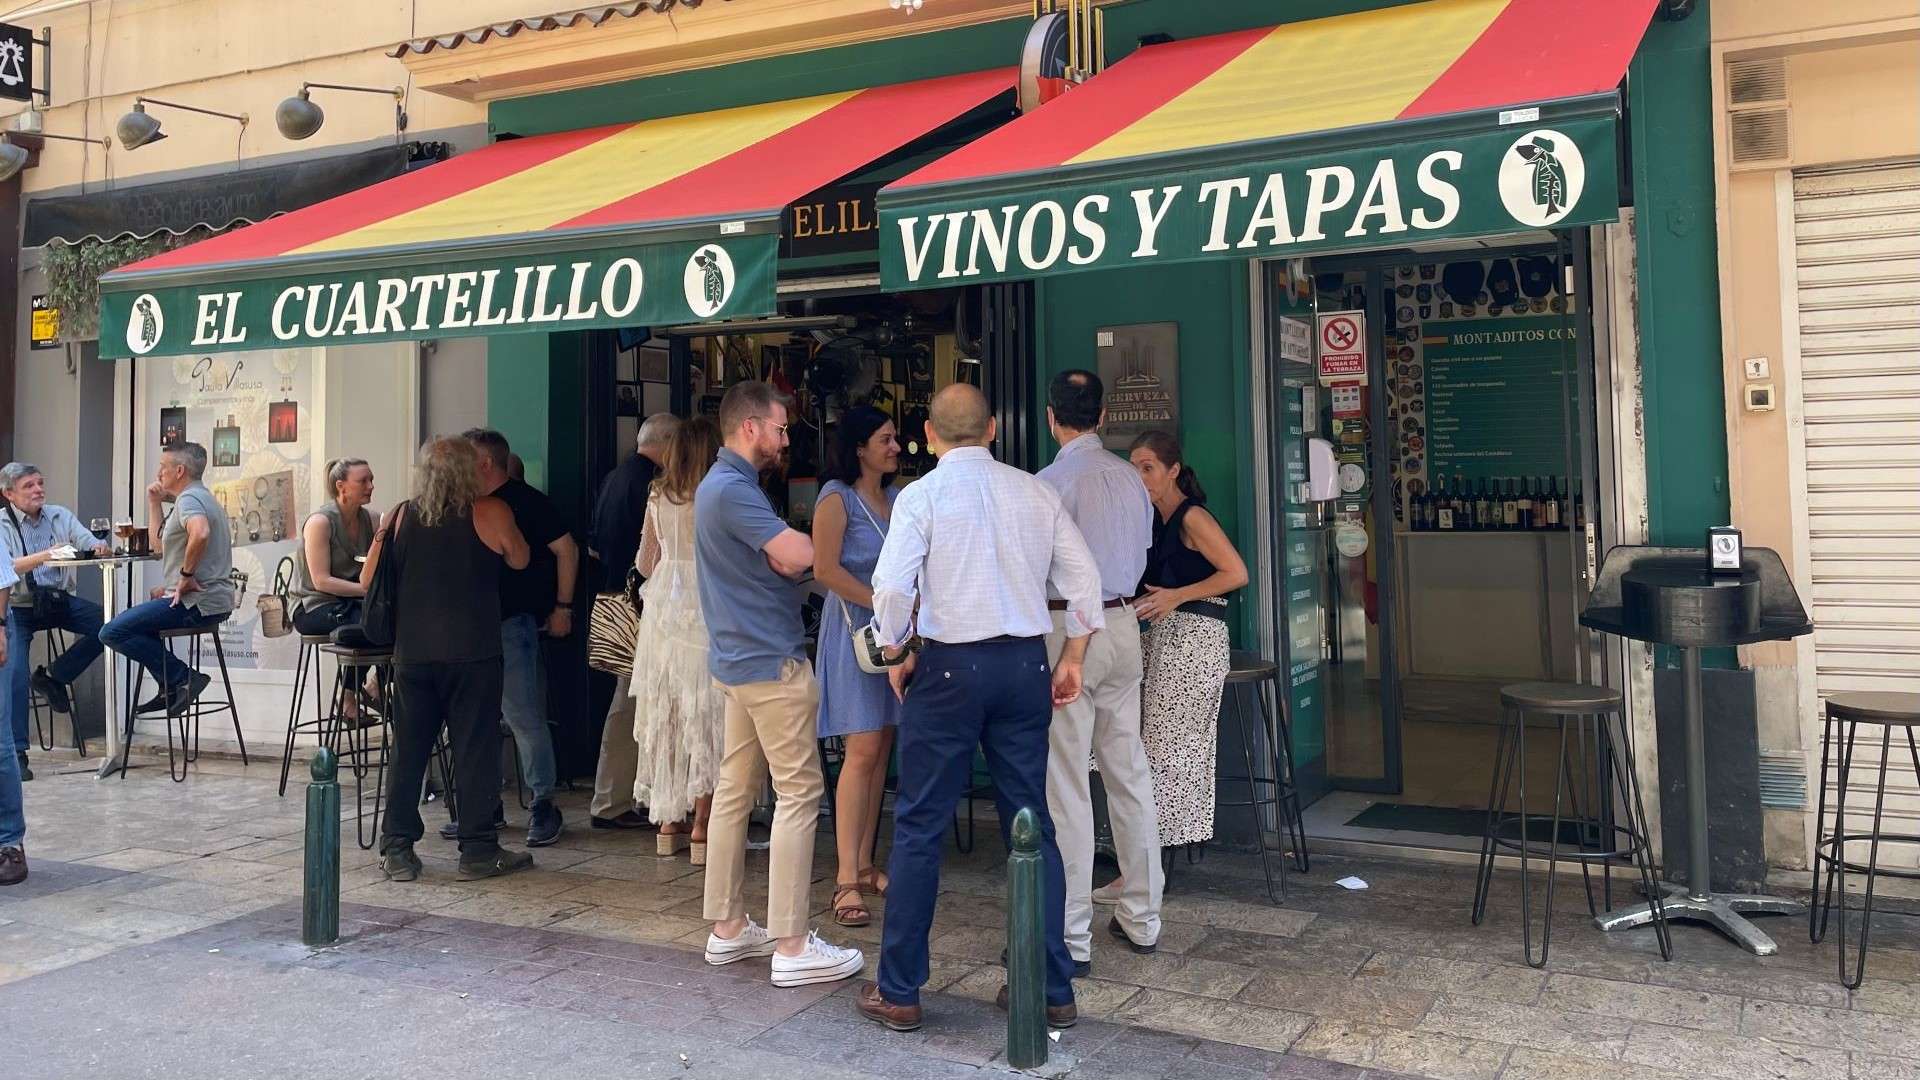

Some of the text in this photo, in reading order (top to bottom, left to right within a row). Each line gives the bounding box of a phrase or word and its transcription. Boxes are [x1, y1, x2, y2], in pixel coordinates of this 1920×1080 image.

[897, 150, 1463, 282] VINOS Y TAPAS
[191, 257, 643, 346] EL CUARTELILLO
[1453, 329, 1545, 345] MONTADITOS
[1108, 391, 1170, 402] CERVEZA
[1109, 410, 1171, 422] BODEGA
